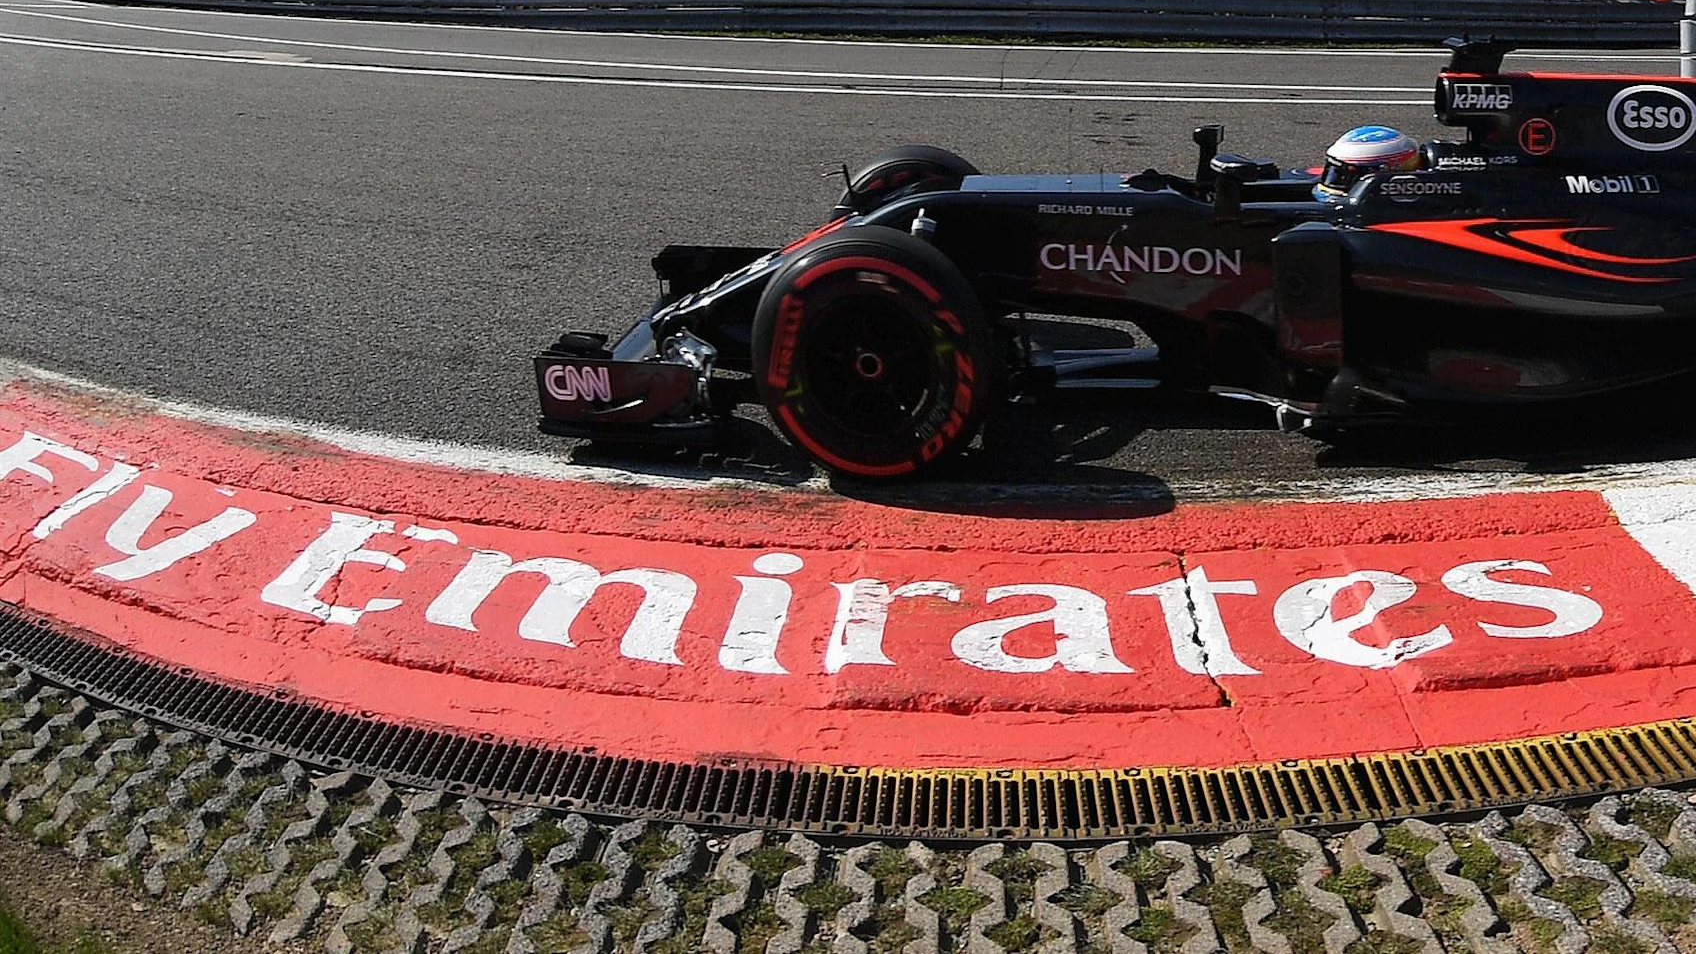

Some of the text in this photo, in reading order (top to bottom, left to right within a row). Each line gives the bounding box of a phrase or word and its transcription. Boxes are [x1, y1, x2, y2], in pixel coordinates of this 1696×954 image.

[1452, 93, 1512, 110] KPMG
[1527, 123, 1547, 151] E
[1437, 155, 1518, 166] MICHAEL KORS
[1379, 182, 1462, 195] SENSODYNE
[1566, 175, 1634, 194] Mobil
[1038, 203, 1134, 217] RICHARD MILLE
[1039, 242, 1242, 276] CHANDON
[545, 364, 612, 402] CNN
[0, 430, 1603, 677] Fly Emirates
